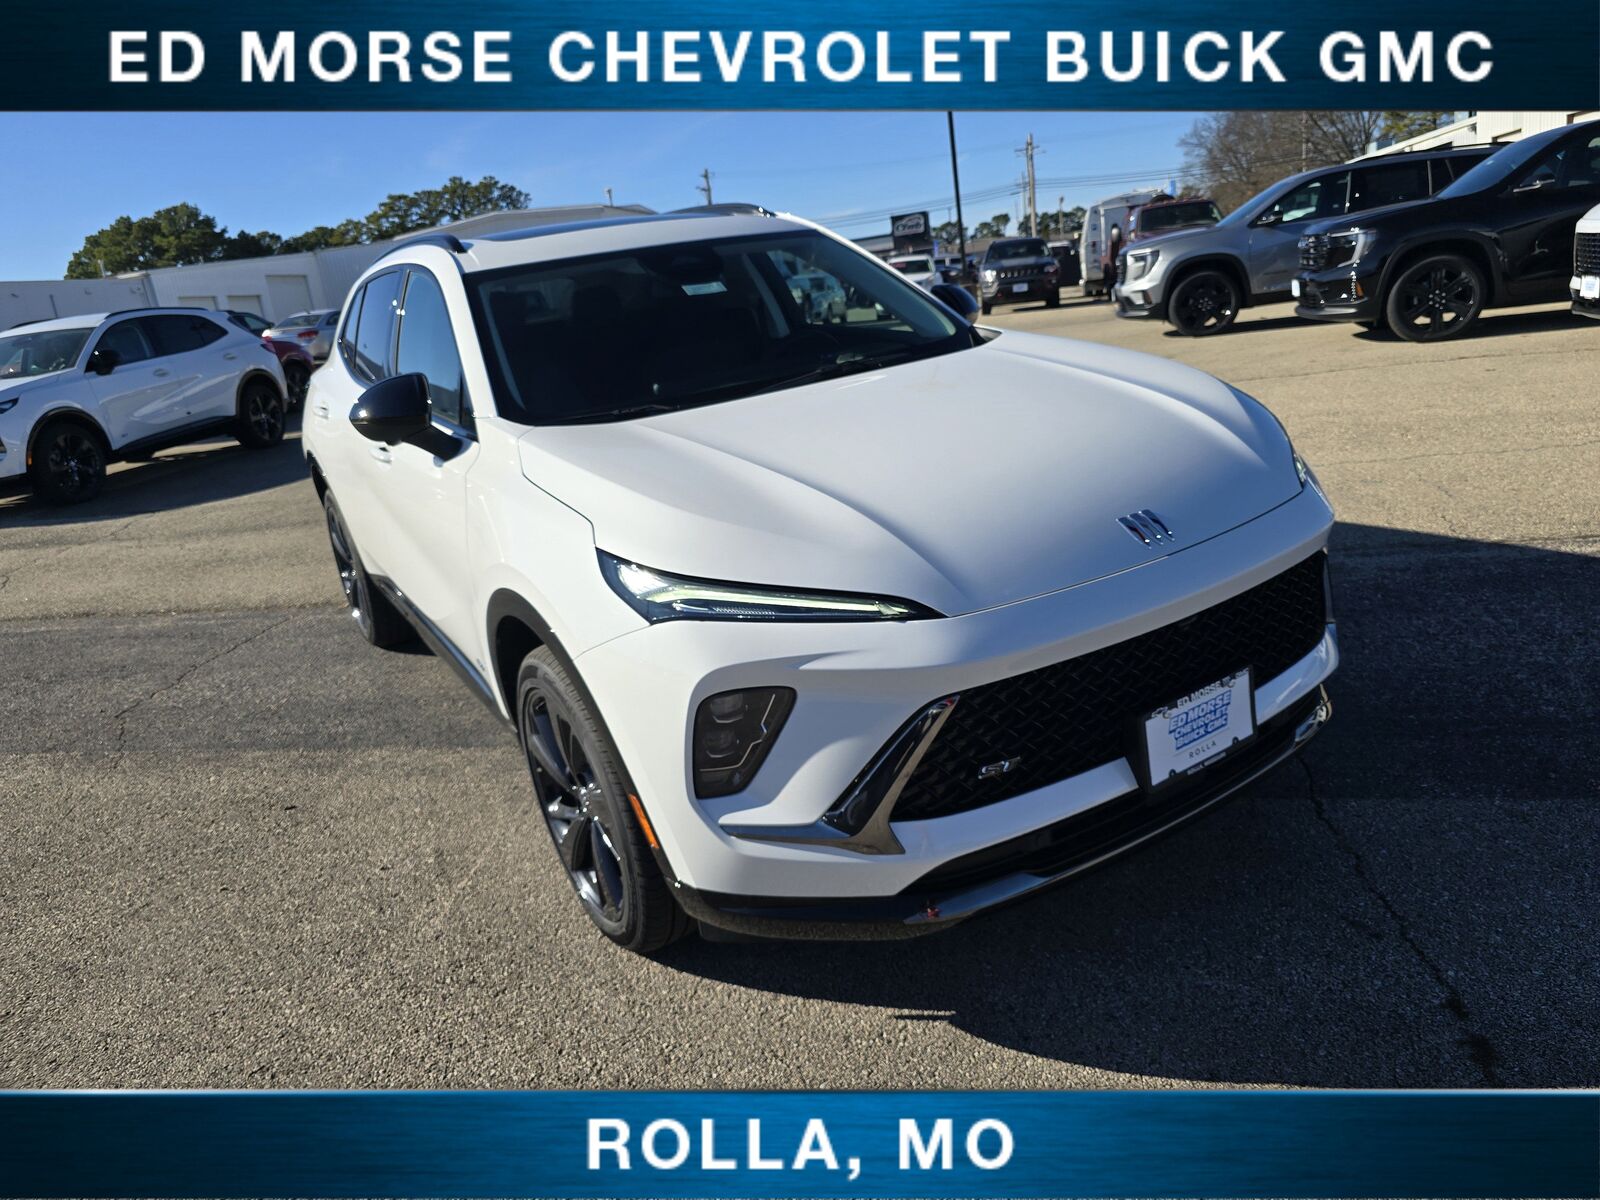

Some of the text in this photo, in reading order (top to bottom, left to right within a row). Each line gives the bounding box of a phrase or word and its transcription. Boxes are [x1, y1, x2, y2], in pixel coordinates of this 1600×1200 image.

[1169, 691, 1232, 732] ED MORSE
[1175, 706, 1229, 738] CHEVROLET
[1176, 715, 1228, 748] BUICK GMC
[1188, 741, 1217, 758] ROLLA
